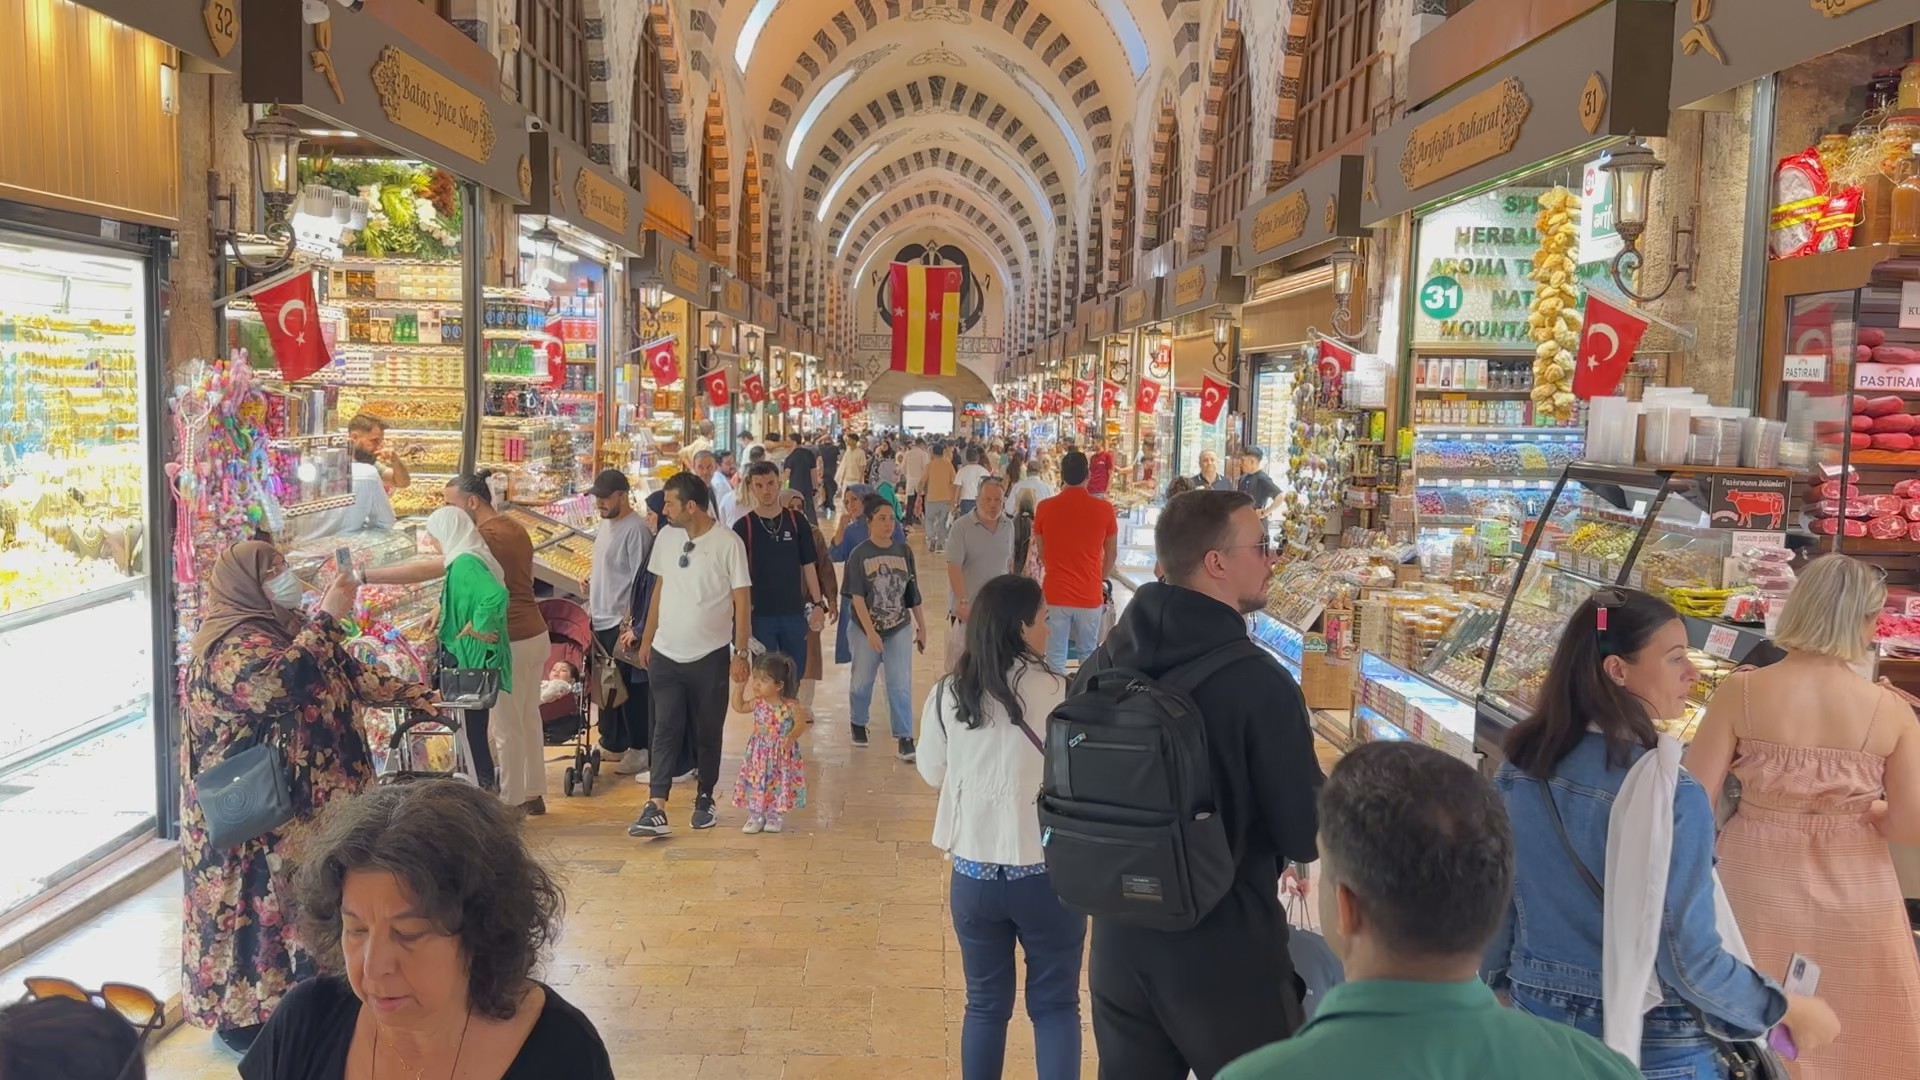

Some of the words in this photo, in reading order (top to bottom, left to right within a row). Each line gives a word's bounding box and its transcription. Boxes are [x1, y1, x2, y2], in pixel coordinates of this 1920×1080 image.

[215, 2, 233, 39] 32
[402, 74, 431, 114] Batas
[433, 91, 457, 126] Spice
[459, 105, 480, 143] Shop
[1584, 88, 1597, 117] 31
[1416, 126, 1455, 168] Arifoğlu
[1456, 104, 1500, 146] Baharat
[1593, 203, 1613, 231] arif
[1429, 258, 1508, 275] AROMA
[1424, 285, 1458, 310] 31
[1491, 290, 1533, 308] NAT
[1440, 320, 1531, 337] MOUNTA
[1785, 367, 1820, 379] PASTIRAMI
